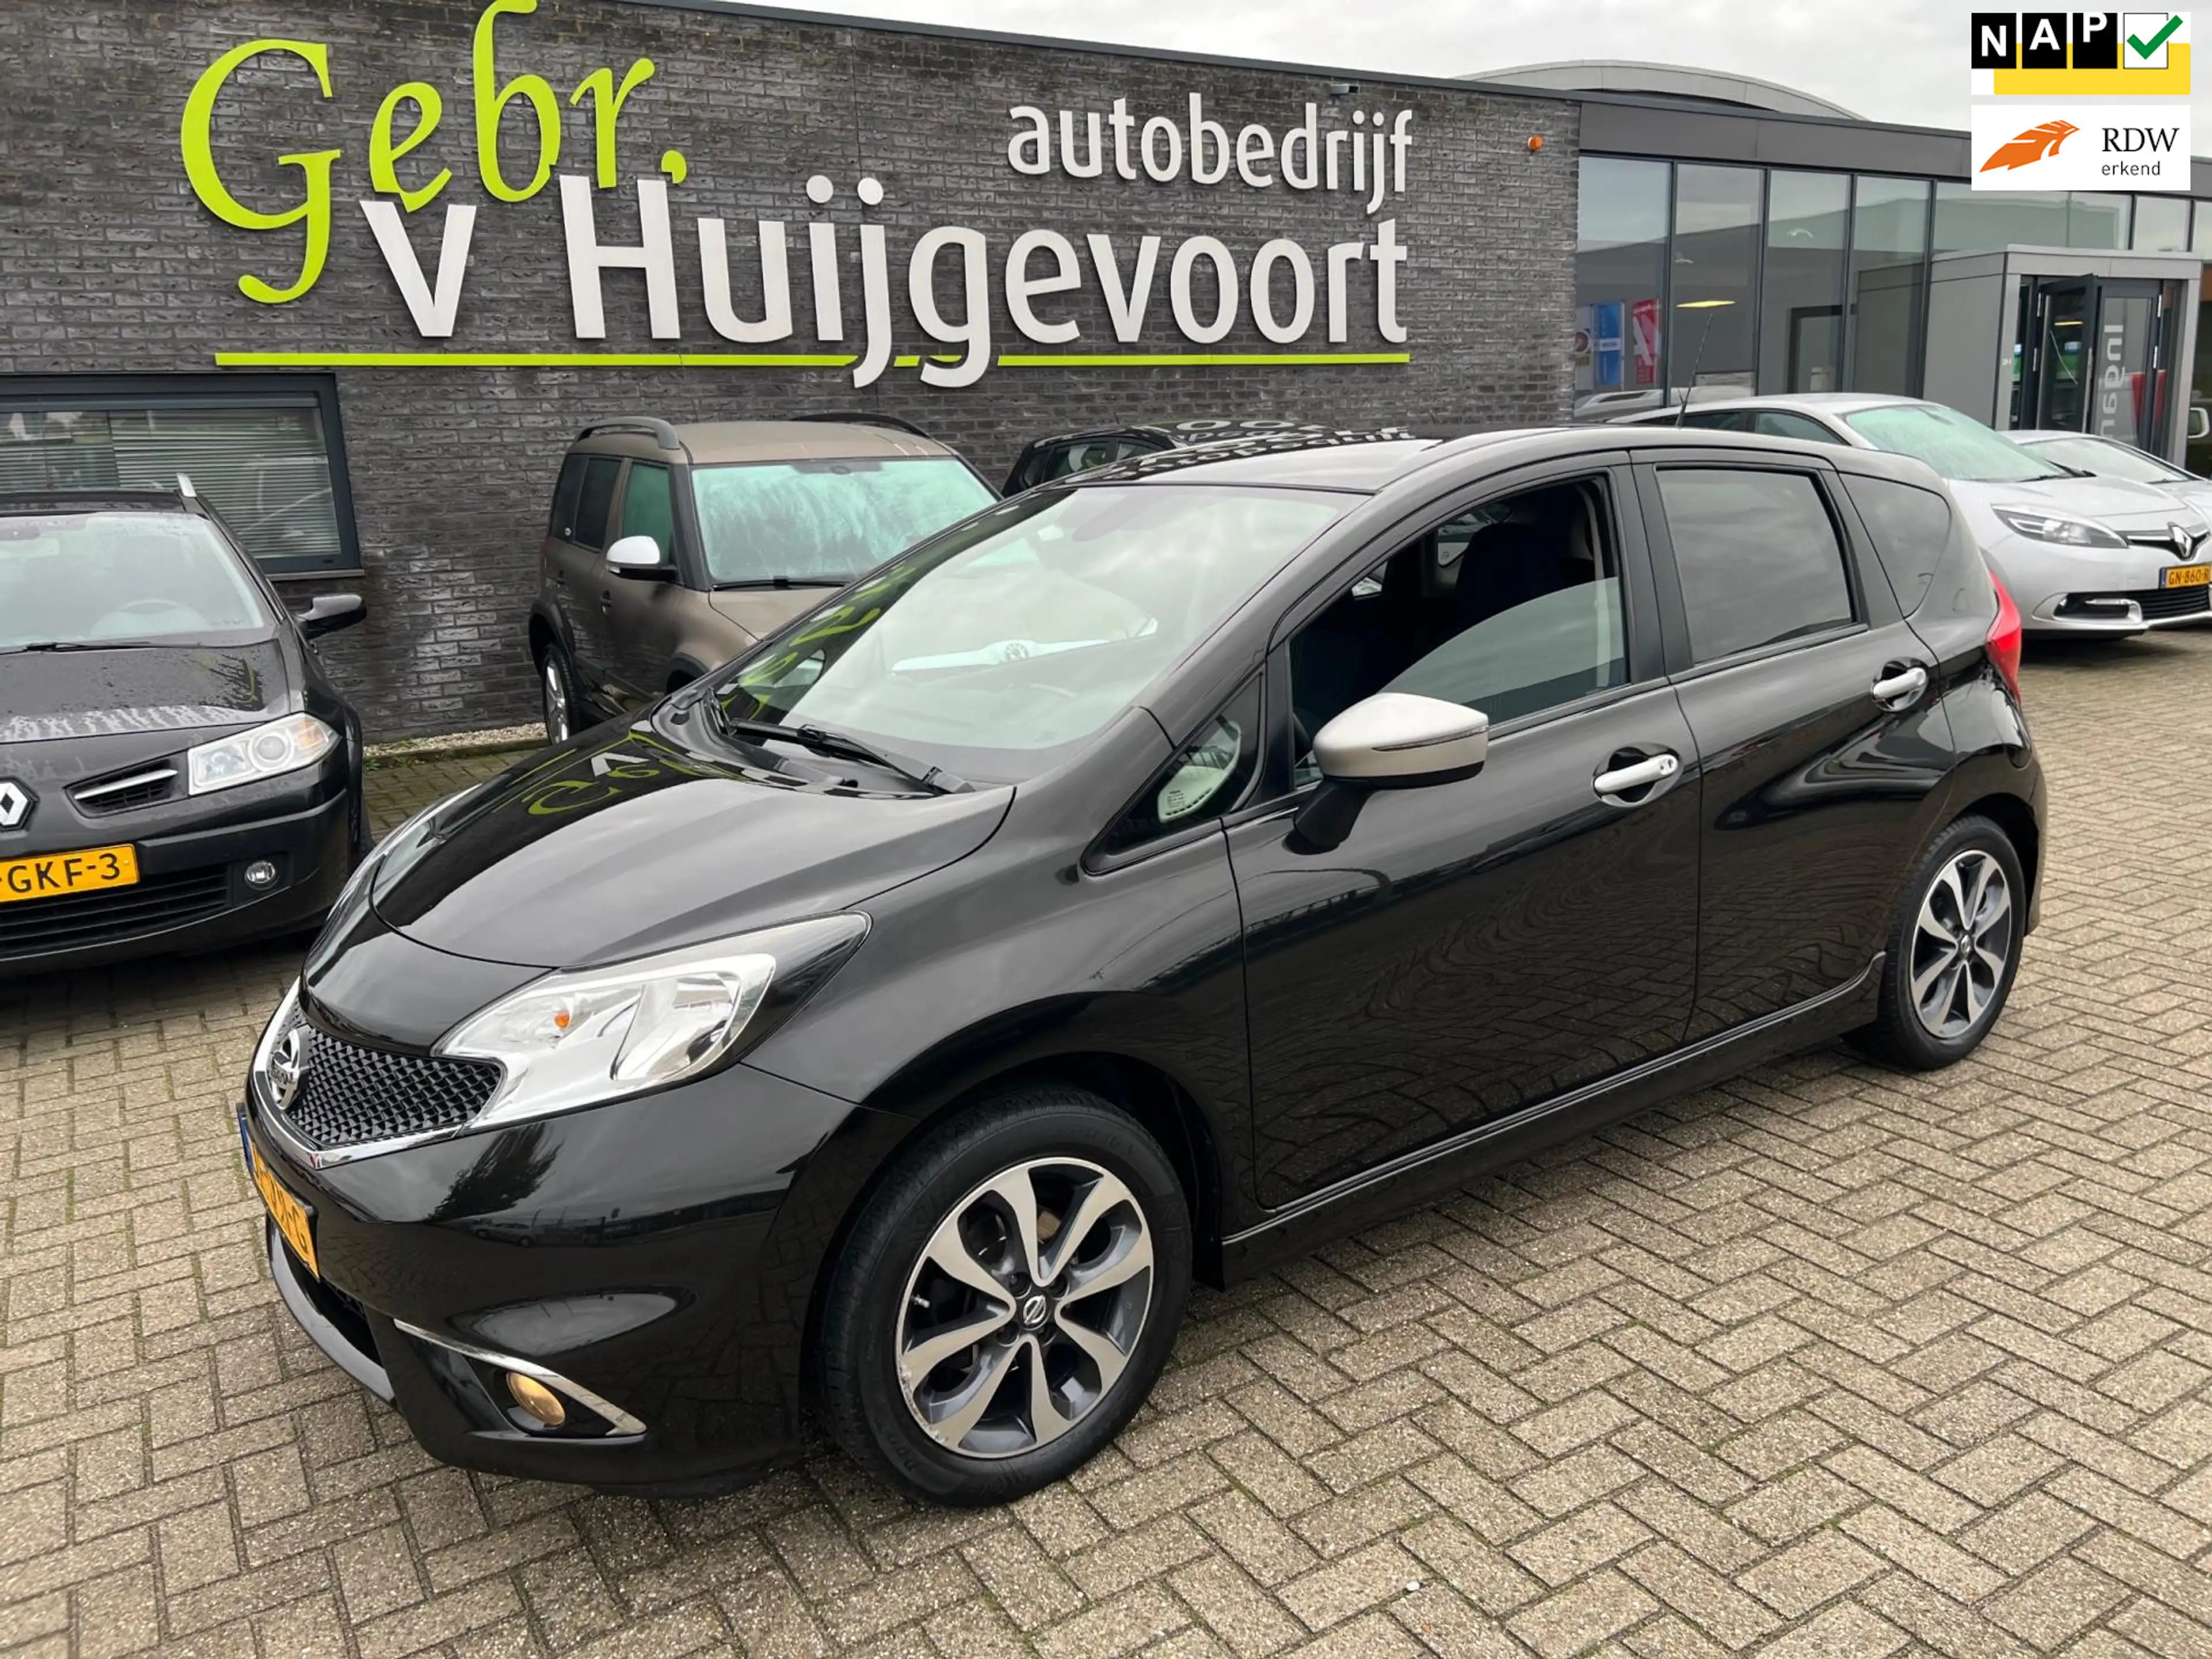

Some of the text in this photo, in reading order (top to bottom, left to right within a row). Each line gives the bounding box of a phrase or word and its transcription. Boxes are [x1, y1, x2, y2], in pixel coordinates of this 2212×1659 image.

[183, 0, 687, 304] Gebr.
[1009, 92, 1412, 215] autobedrijf
[559, 175, 1407, 388] Huijgevoort
[0, 853, 120, 893] GKF-3
